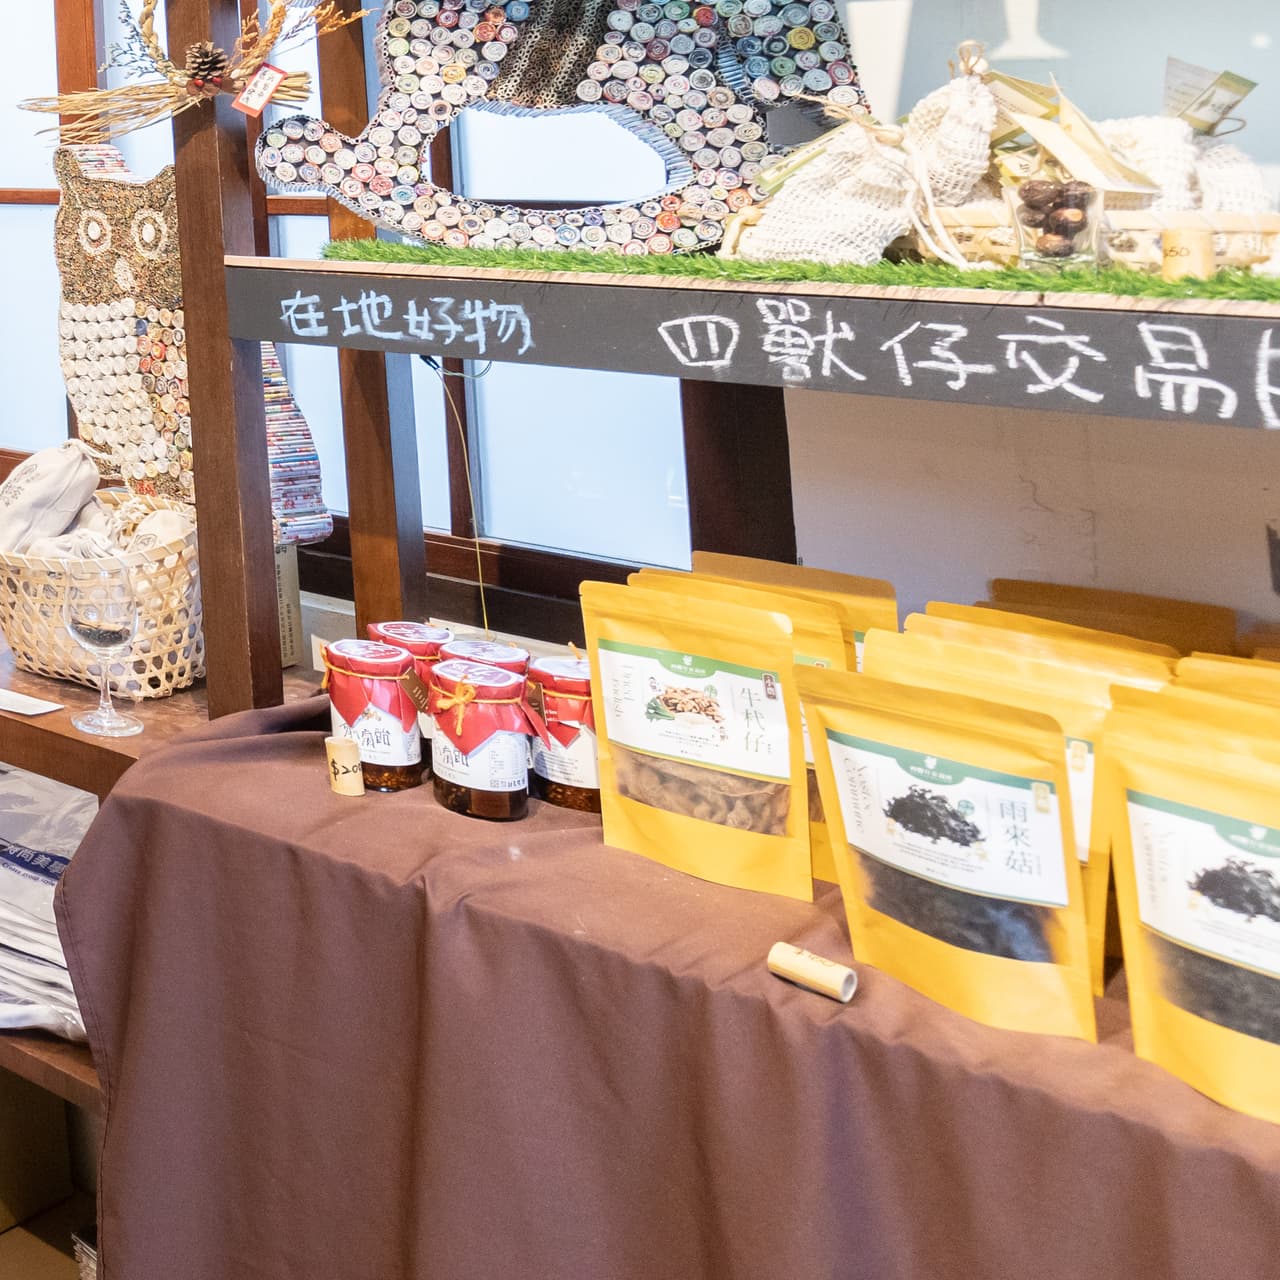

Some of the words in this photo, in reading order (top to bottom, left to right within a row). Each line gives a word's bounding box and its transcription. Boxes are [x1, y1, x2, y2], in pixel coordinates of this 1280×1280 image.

[279, 289, 535, 355] 在地好物
[656, 297, 1280, 428] 四獸仔交易
